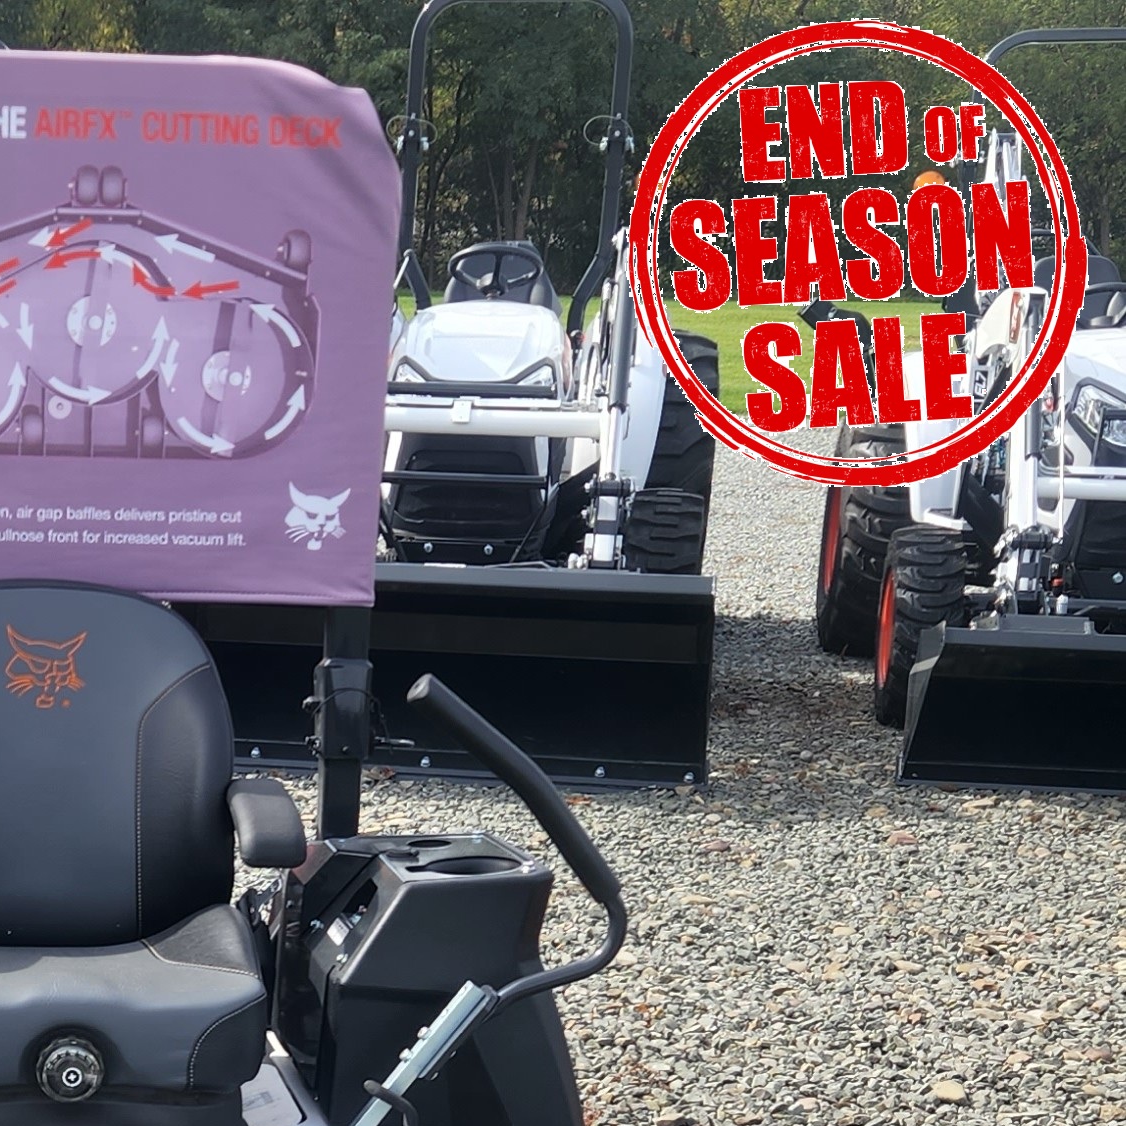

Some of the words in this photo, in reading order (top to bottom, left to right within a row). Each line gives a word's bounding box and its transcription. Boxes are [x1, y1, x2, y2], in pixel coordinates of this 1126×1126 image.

[141, 110, 260, 146] CUTTING
[269, 115, 343, 150] DECK
[17, 506, 34, 519] air
[37, 509, 63, 522] gap
[66, 507, 112, 521] baffles
[115, 508, 166, 522] delivers
[169, 510, 218, 524] pristine
[221, 511, 243, 523] cut
[48, 530, 79, 544] front
[82, 530, 101, 544] for
[104, 532, 169, 546] increased
[172, 534, 224, 547] vacuum
[227, 533, 246, 547] lift.
